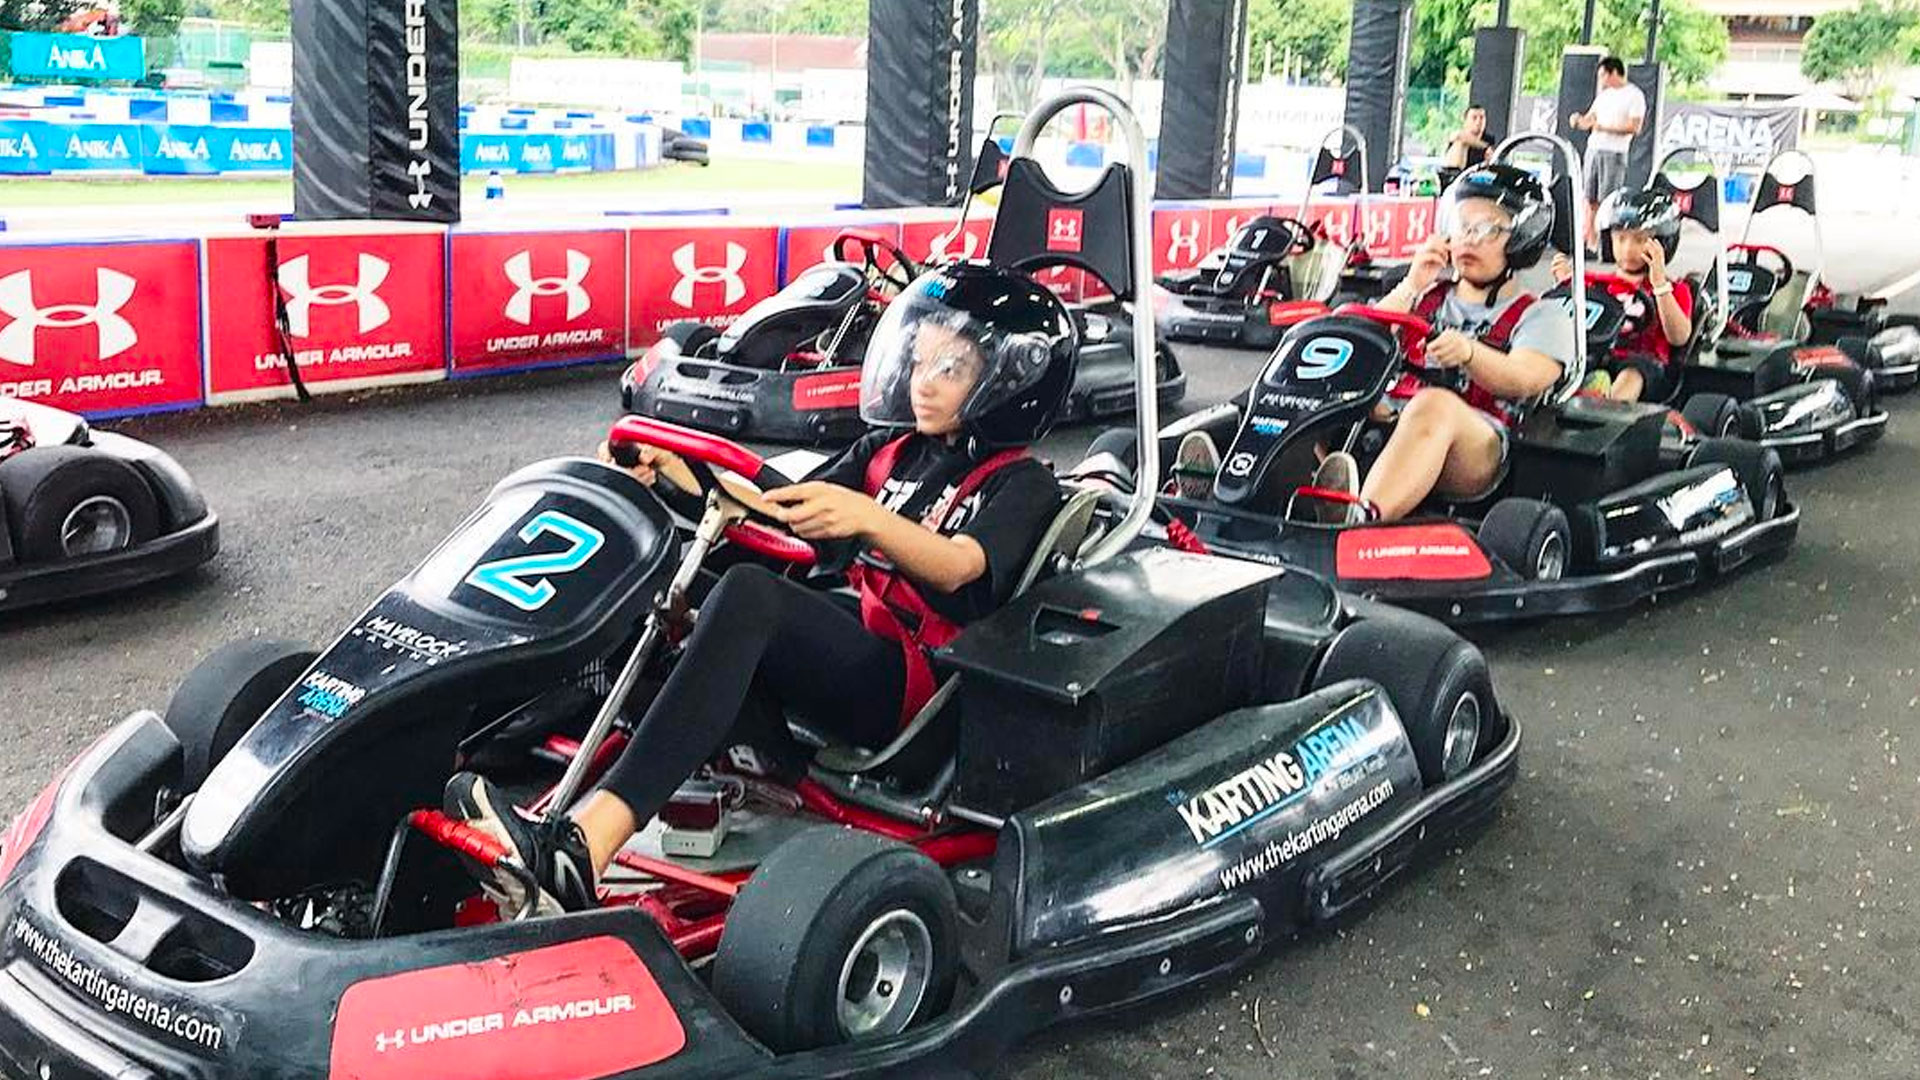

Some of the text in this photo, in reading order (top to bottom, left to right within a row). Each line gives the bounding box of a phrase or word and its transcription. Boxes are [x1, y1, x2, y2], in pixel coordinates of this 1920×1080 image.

[48, 43, 107, 70] ANIKA
[405, 0, 429, 150] UNDER
[946, 50, 963, 157] UNDER
[64, 132, 132, 159] ANIKA
[155, 135, 211, 161] ANIKA
[228, 137, 284, 161] ANIKA
[1664, 112, 1774, 150] ARENA
[486, 328, 604, 353] UNDER ARMOUR
[1295, 336, 1355, 380] 9
[254, 349, 325, 371] UNER
[0, 378, 52, 398] DER
[1176, 751, 1305, 844] KARTING
[1219, 778, 1394, 891] www.thekartingarena.com
[13, 916, 223, 1050] www.thekartingarena.com
[410, 994, 636, 1044] UNDER ARMOUR
